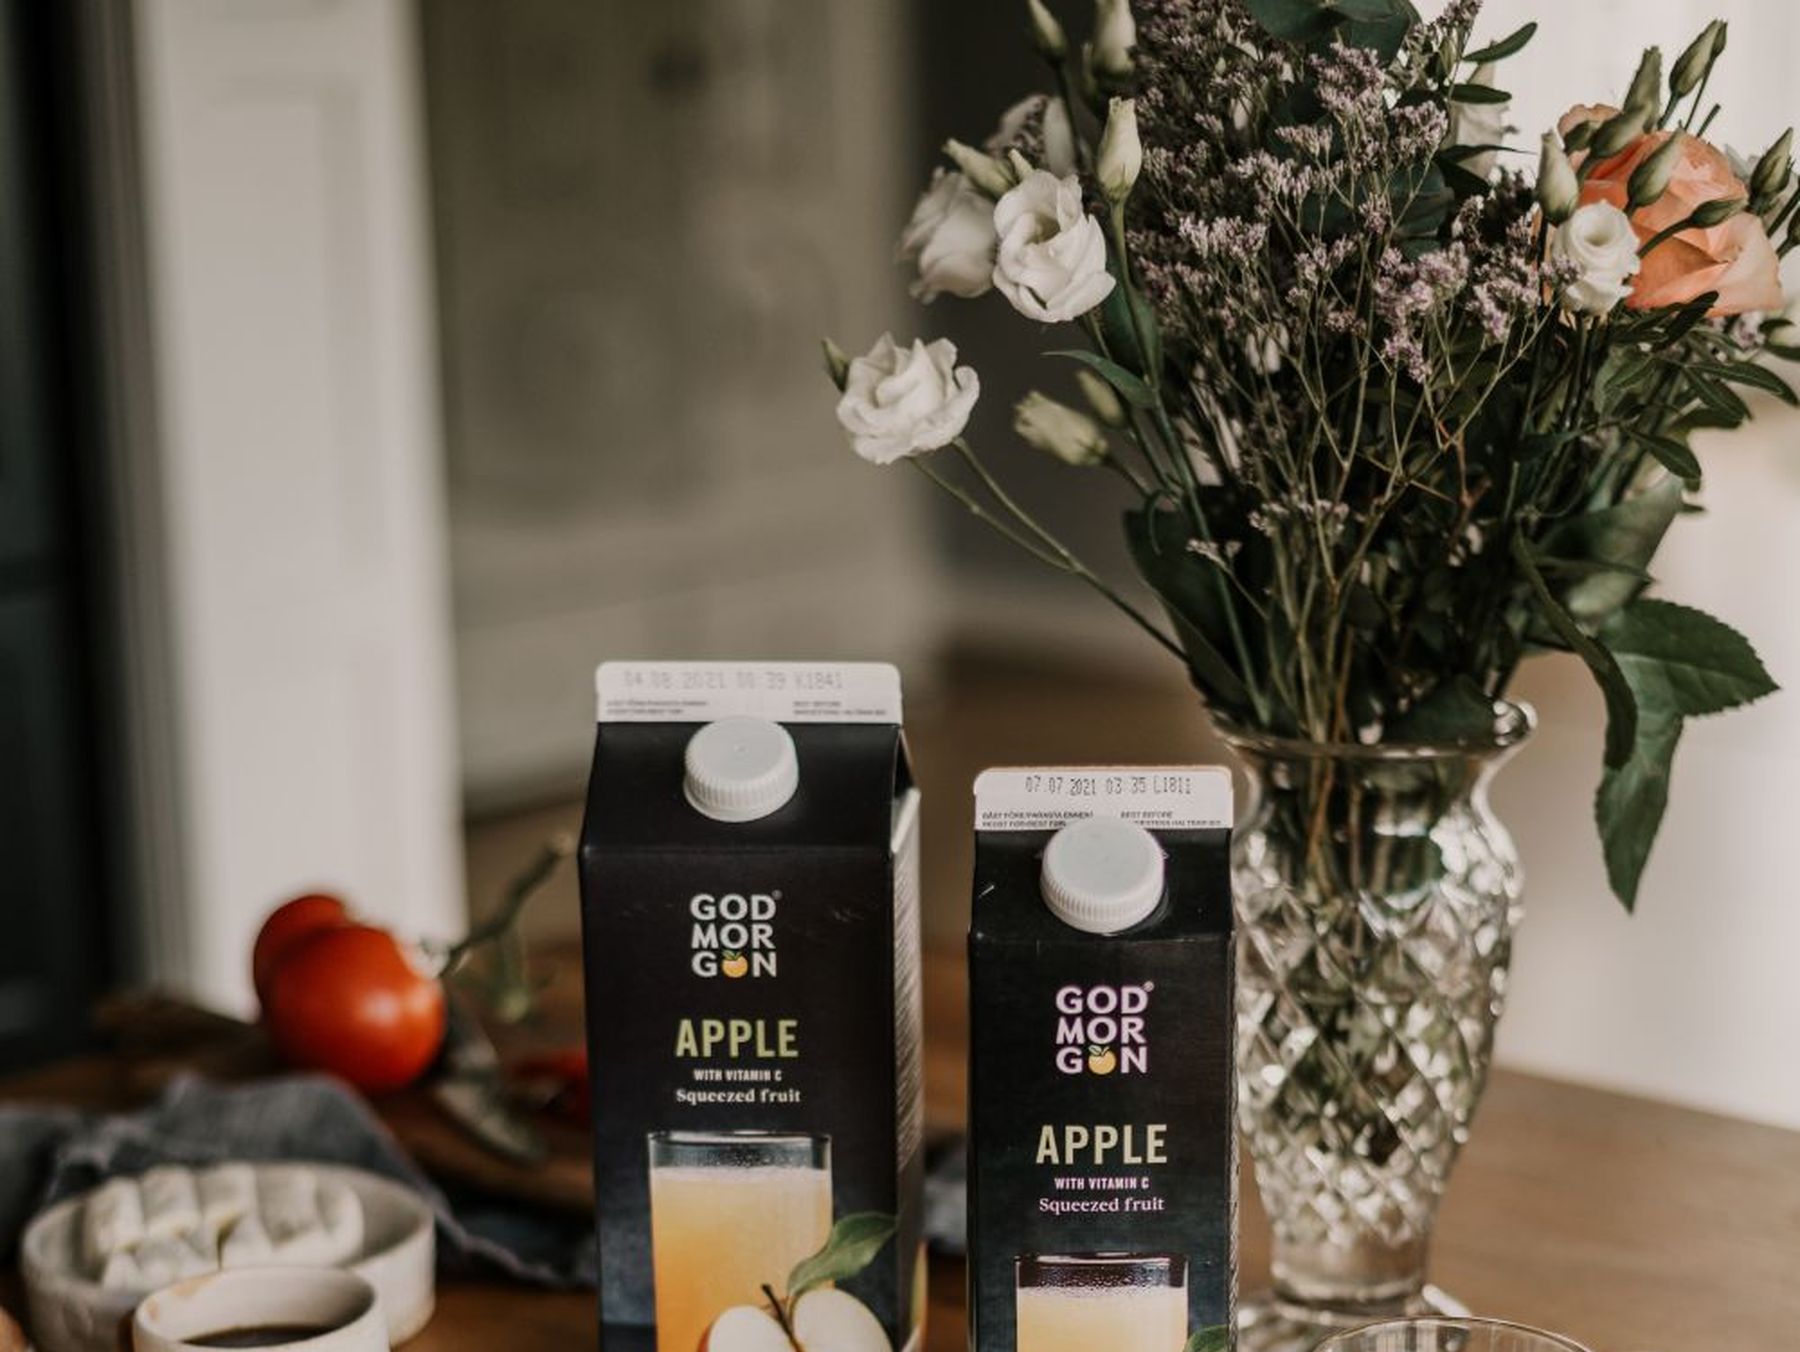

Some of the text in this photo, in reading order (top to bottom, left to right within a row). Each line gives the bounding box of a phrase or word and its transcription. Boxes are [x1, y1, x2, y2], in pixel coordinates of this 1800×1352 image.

[690, 893, 777, 921] GOD
[691, 923, 776, 950] MOR
[1055, 985, 1149, 1015] GOD
[675, 1018, 799, 1058] APPLE
[1055, 1016, 1148, 1045] MOR
[693, 1069, 782, 1081] WITH VITAMIN C
[676, 1087, 801, 1106] Squeezed fruit
[1036, 1123, 1168, 1165] APPLE
[1054, 1177, 1150, 1190] WITH VITAMIN C
[1039, 1196, 1165, 1216] Squeezed fruit
